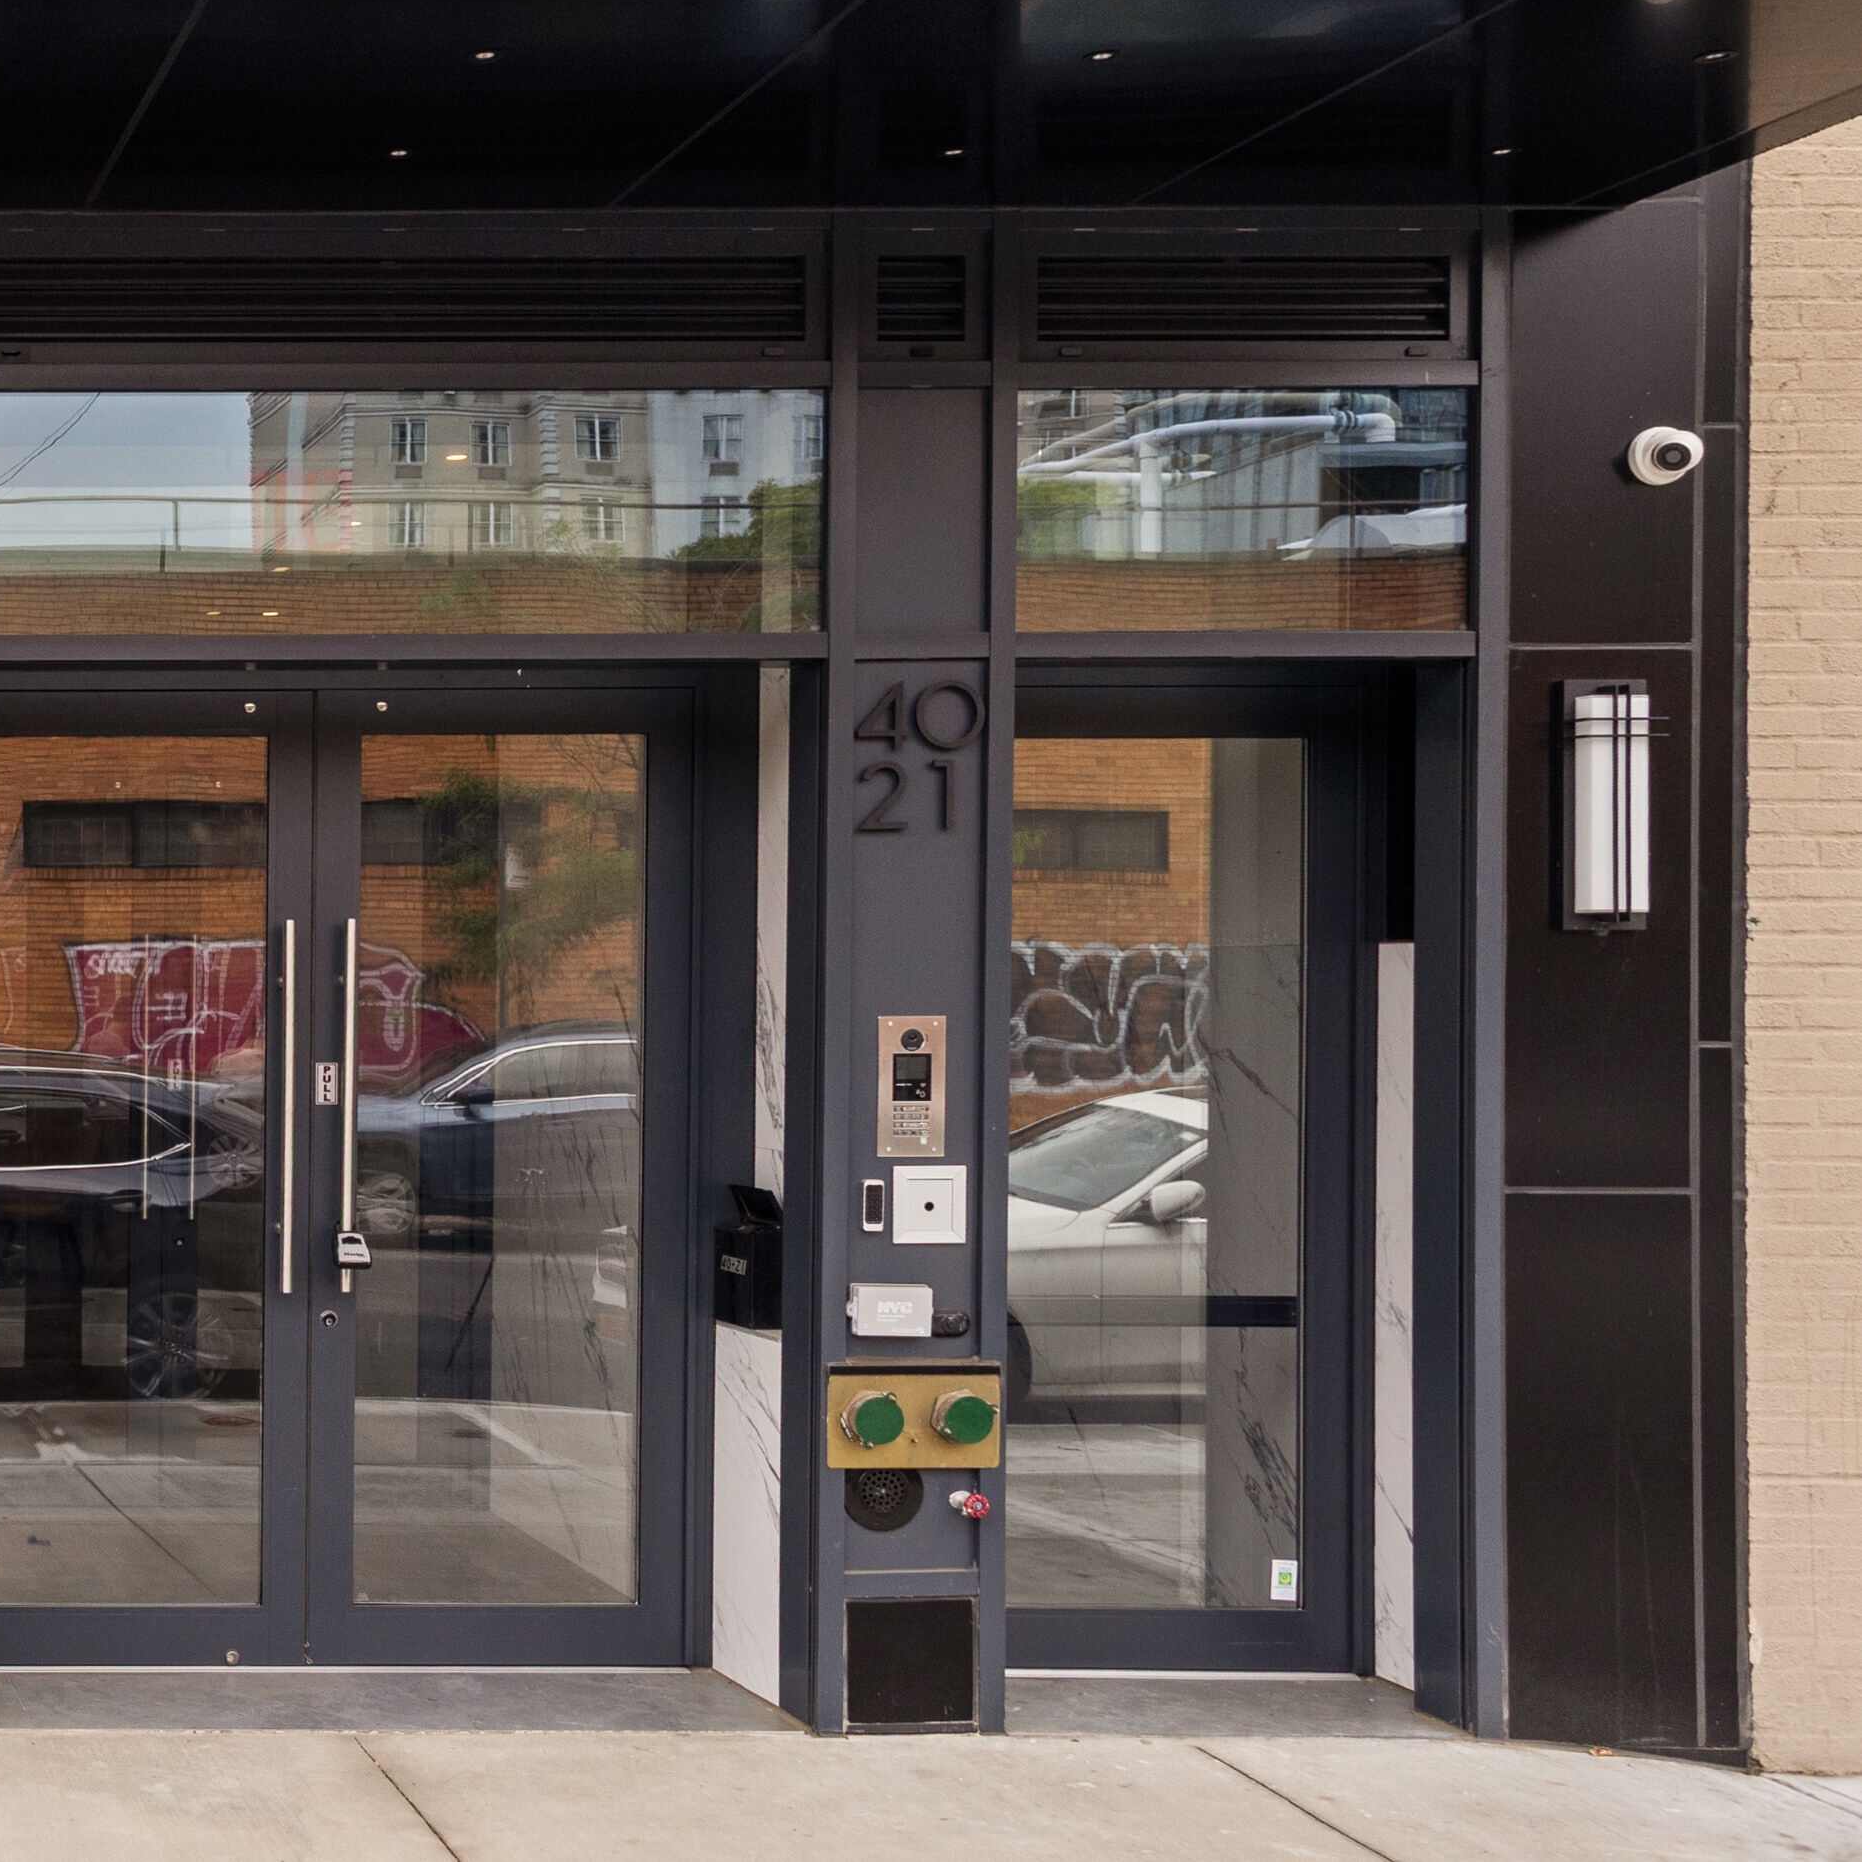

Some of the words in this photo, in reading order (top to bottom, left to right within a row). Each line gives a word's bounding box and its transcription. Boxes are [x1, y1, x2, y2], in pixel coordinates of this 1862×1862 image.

[854, 680, 986, 752] 40
[855, 759, 957, 833] 21
[322, 1065, 332, 1102] PULL
[876, 1301, 914, 1314] NYC
